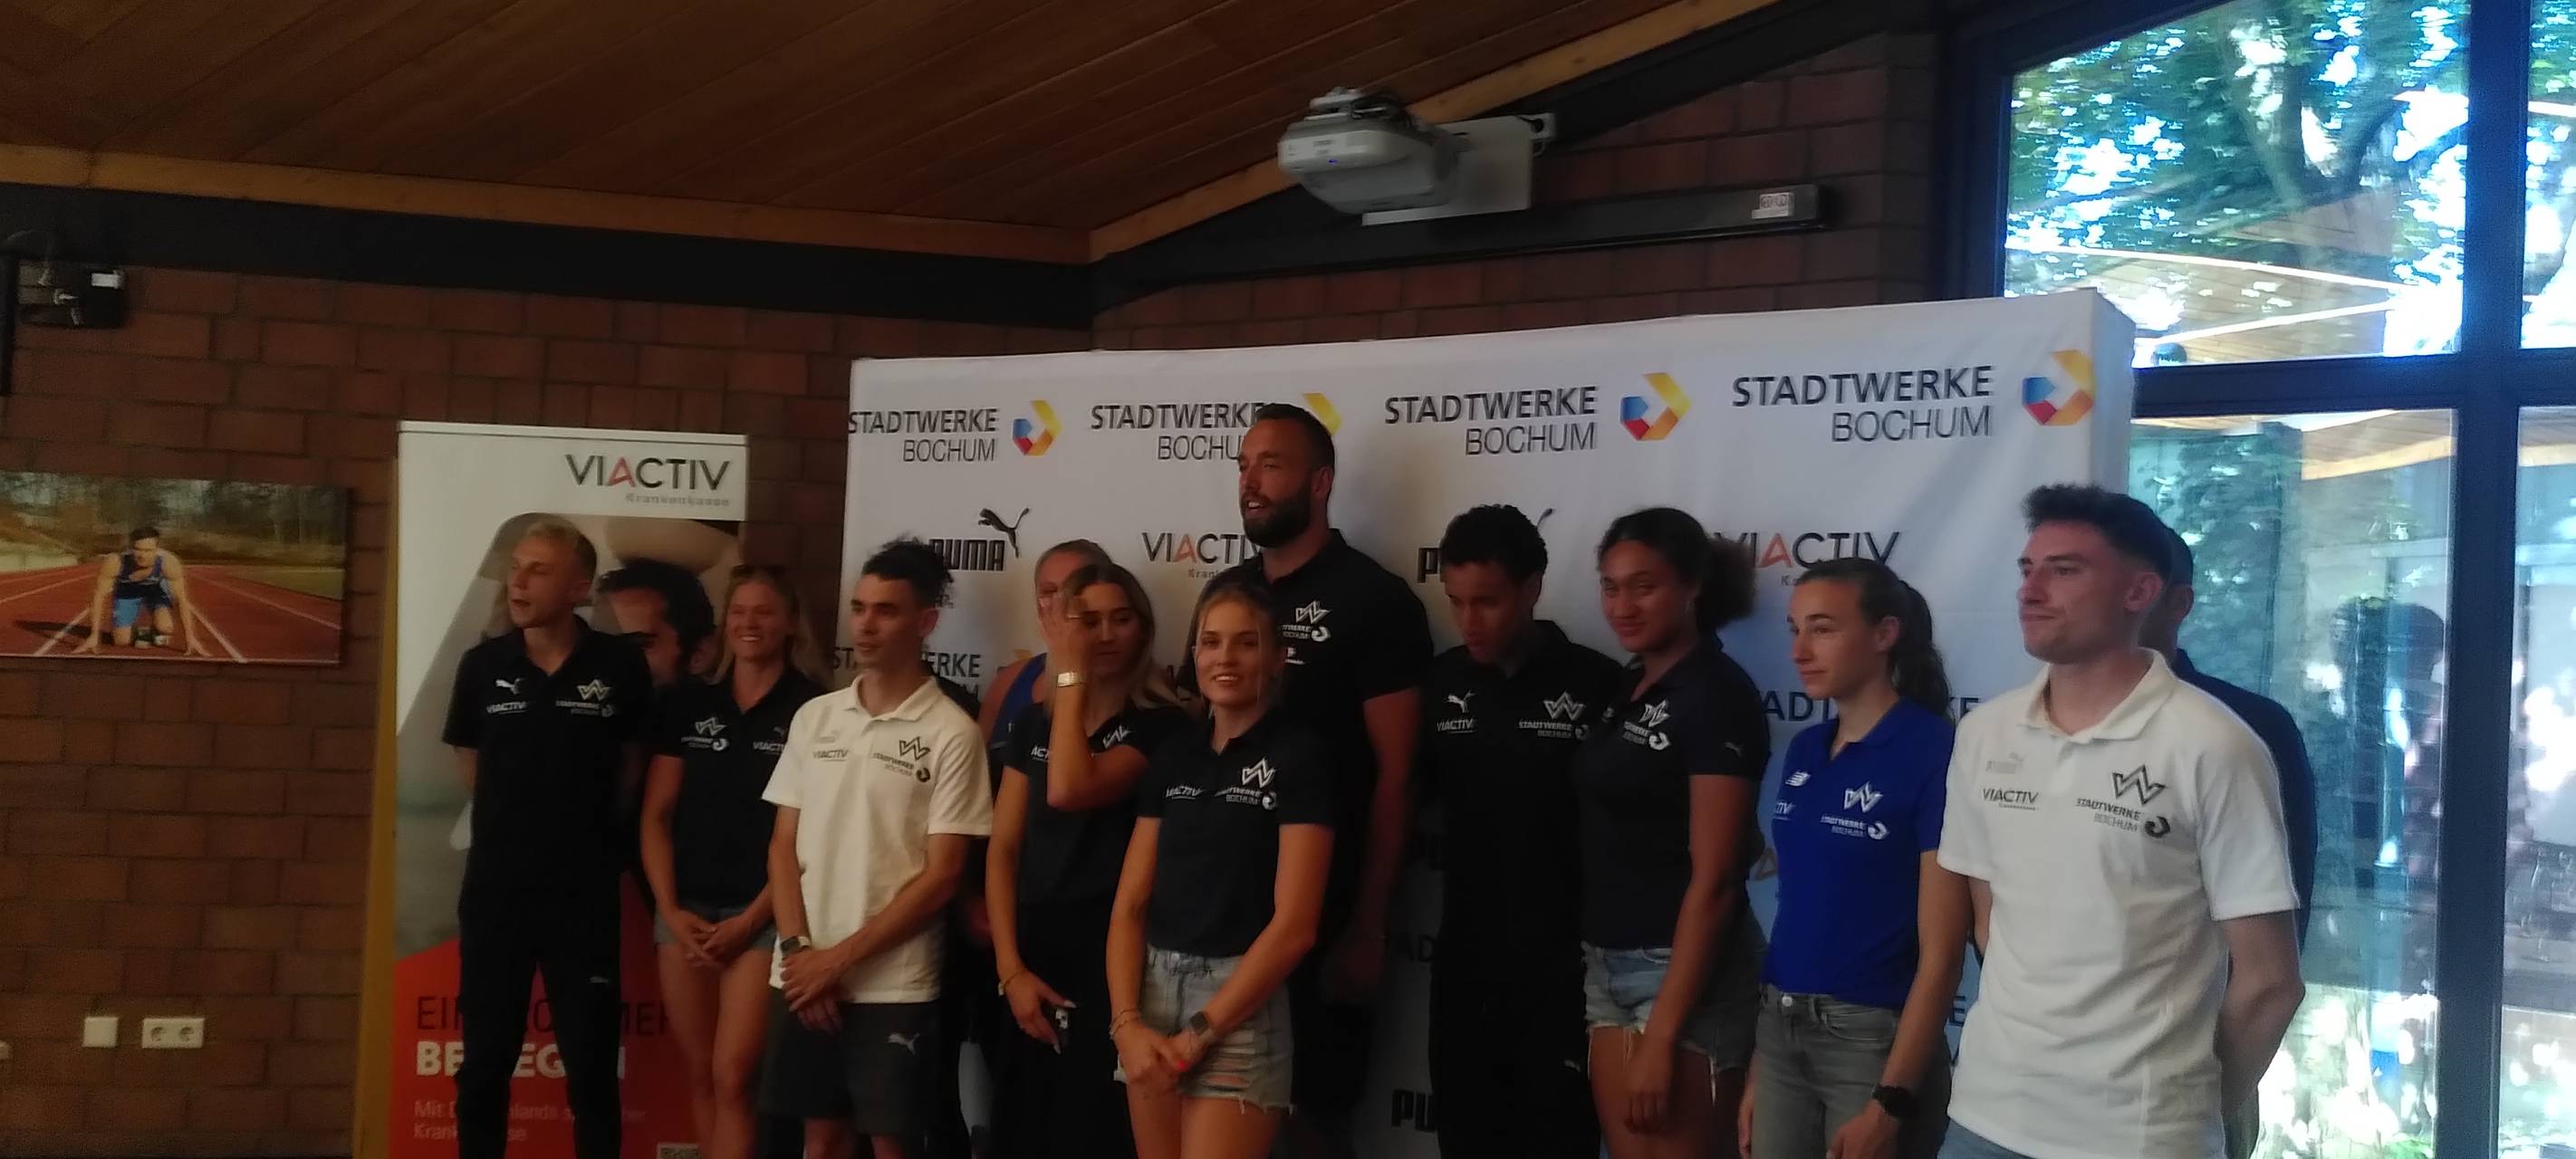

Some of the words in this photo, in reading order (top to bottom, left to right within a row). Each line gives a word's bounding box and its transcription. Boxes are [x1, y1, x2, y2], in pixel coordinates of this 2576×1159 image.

[1732, 365, 1993, 407] STADTWERKE
[1384, 386, 1597, 424] STADTWERKE
[848, 408, 998, 434] STADTWERKE
[1831, 406, 1991, 442] BOCHUM
[903, 438, 996, 462] BOCHUM
[1157, 435, 1245, 460] BOCHU
[1466, 421, 1596, 455] BOCHUM
[565, 454, 730, 490] VIACTIV
[1982, 788, 2039, 804] VIACTIV
[2076, 798, 2141, 821] STADTWERKE
